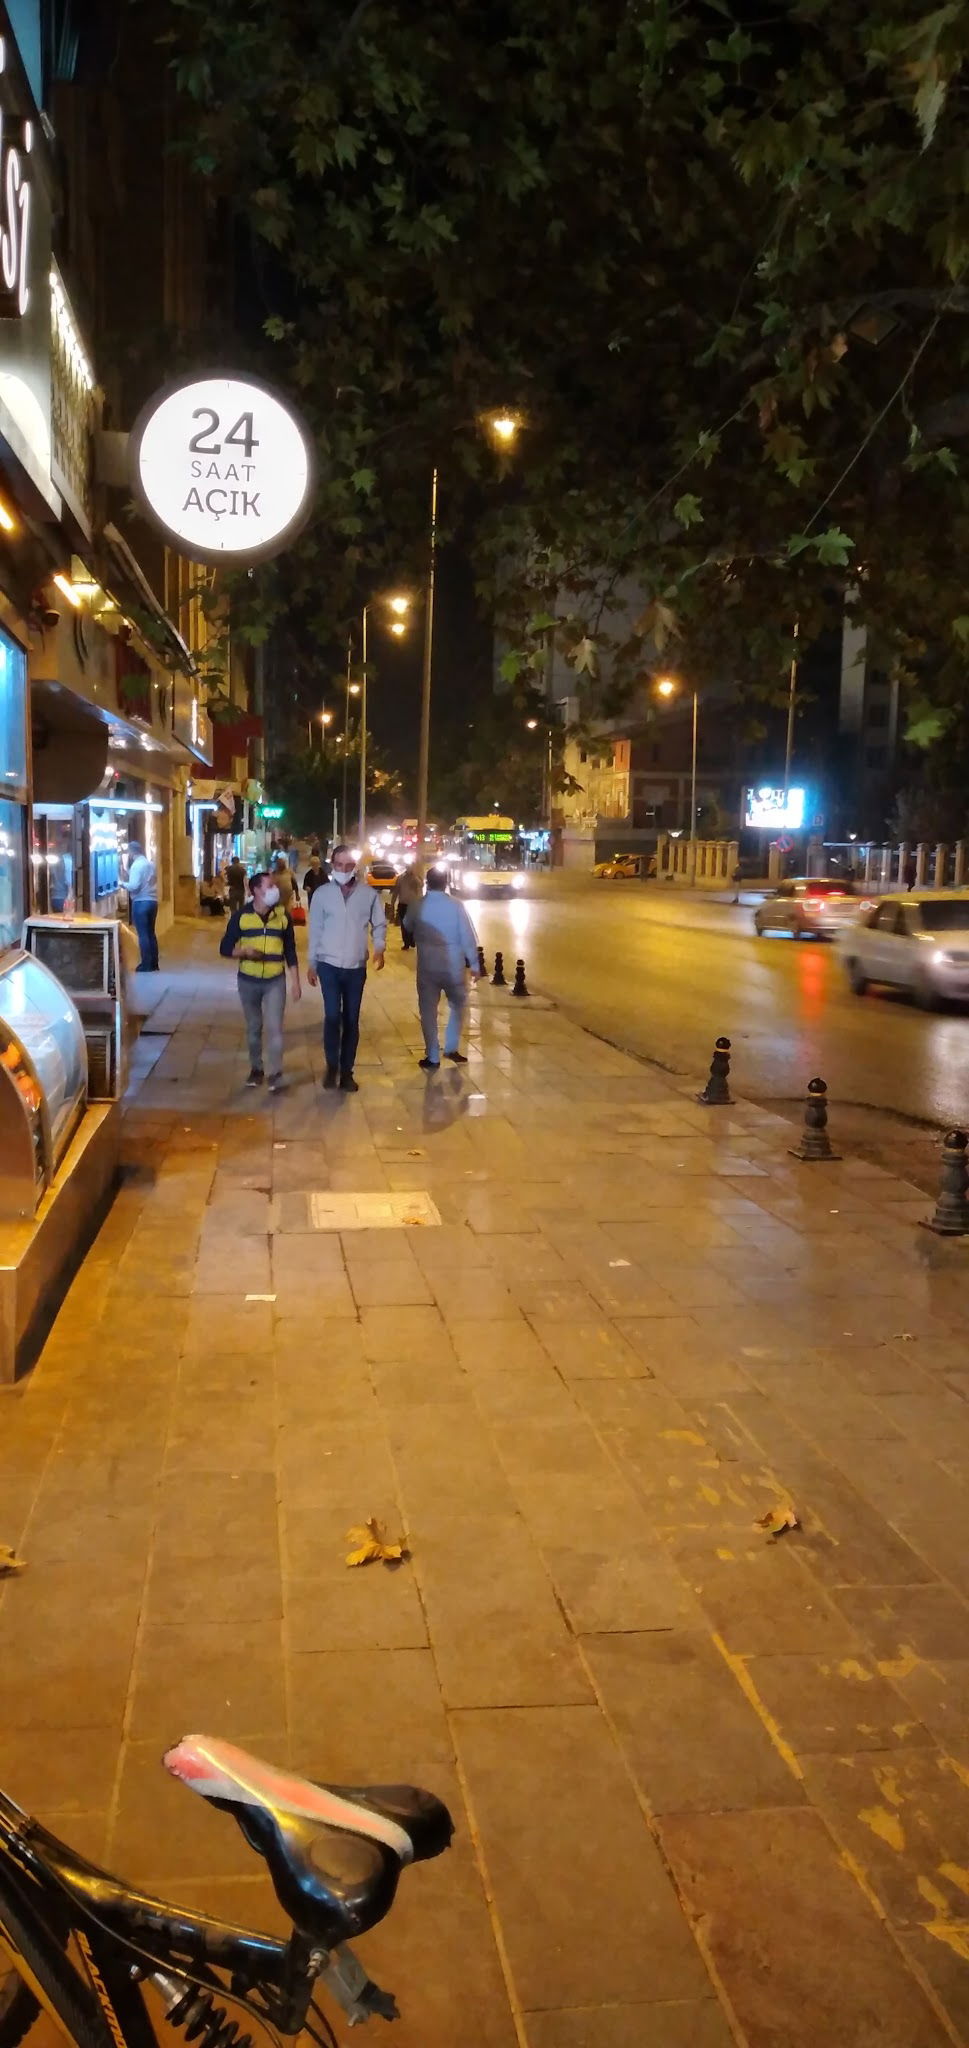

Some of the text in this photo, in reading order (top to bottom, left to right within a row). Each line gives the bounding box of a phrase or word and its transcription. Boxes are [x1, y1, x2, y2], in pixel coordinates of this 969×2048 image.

[189, 407, 259, 458] 24
[191, 460, 256, 482] SAAT
[182, 487, 261, 521] AÇIK
